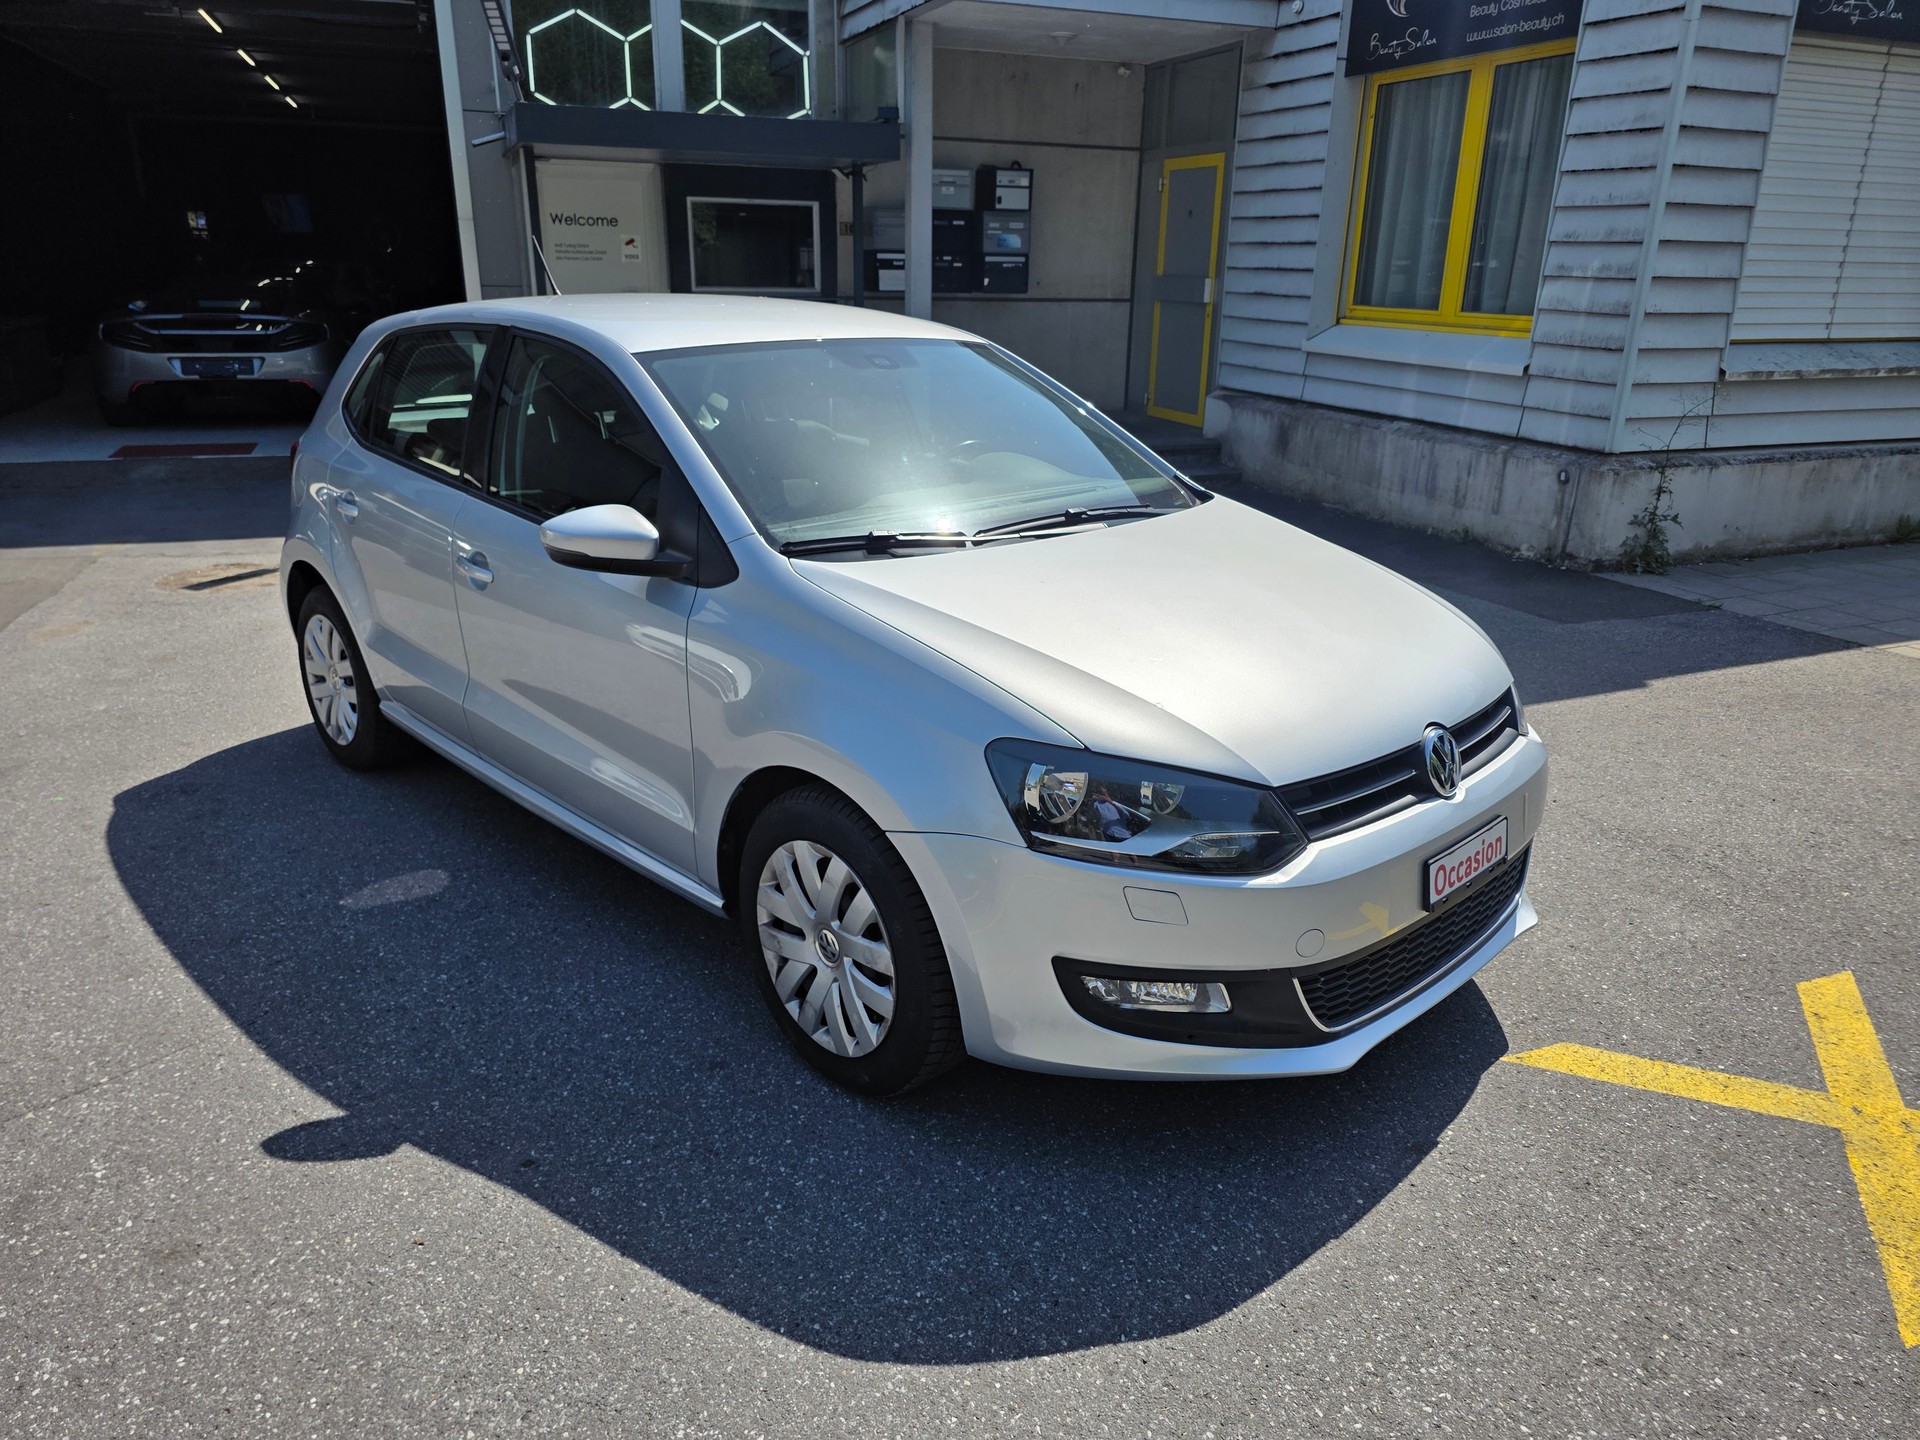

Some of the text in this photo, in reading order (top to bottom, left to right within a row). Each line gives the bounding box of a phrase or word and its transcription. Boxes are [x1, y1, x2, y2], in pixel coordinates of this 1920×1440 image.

[1470, 3, 1499, 17] Beauty
[1466, 12, 1565, 42] www.salon-beauty.ch
[1366, 27, 1437, 60] Beauty Salon
[549, 212, 619, 227] Welcome
[1434, 835, 1503, 897] Occasion
